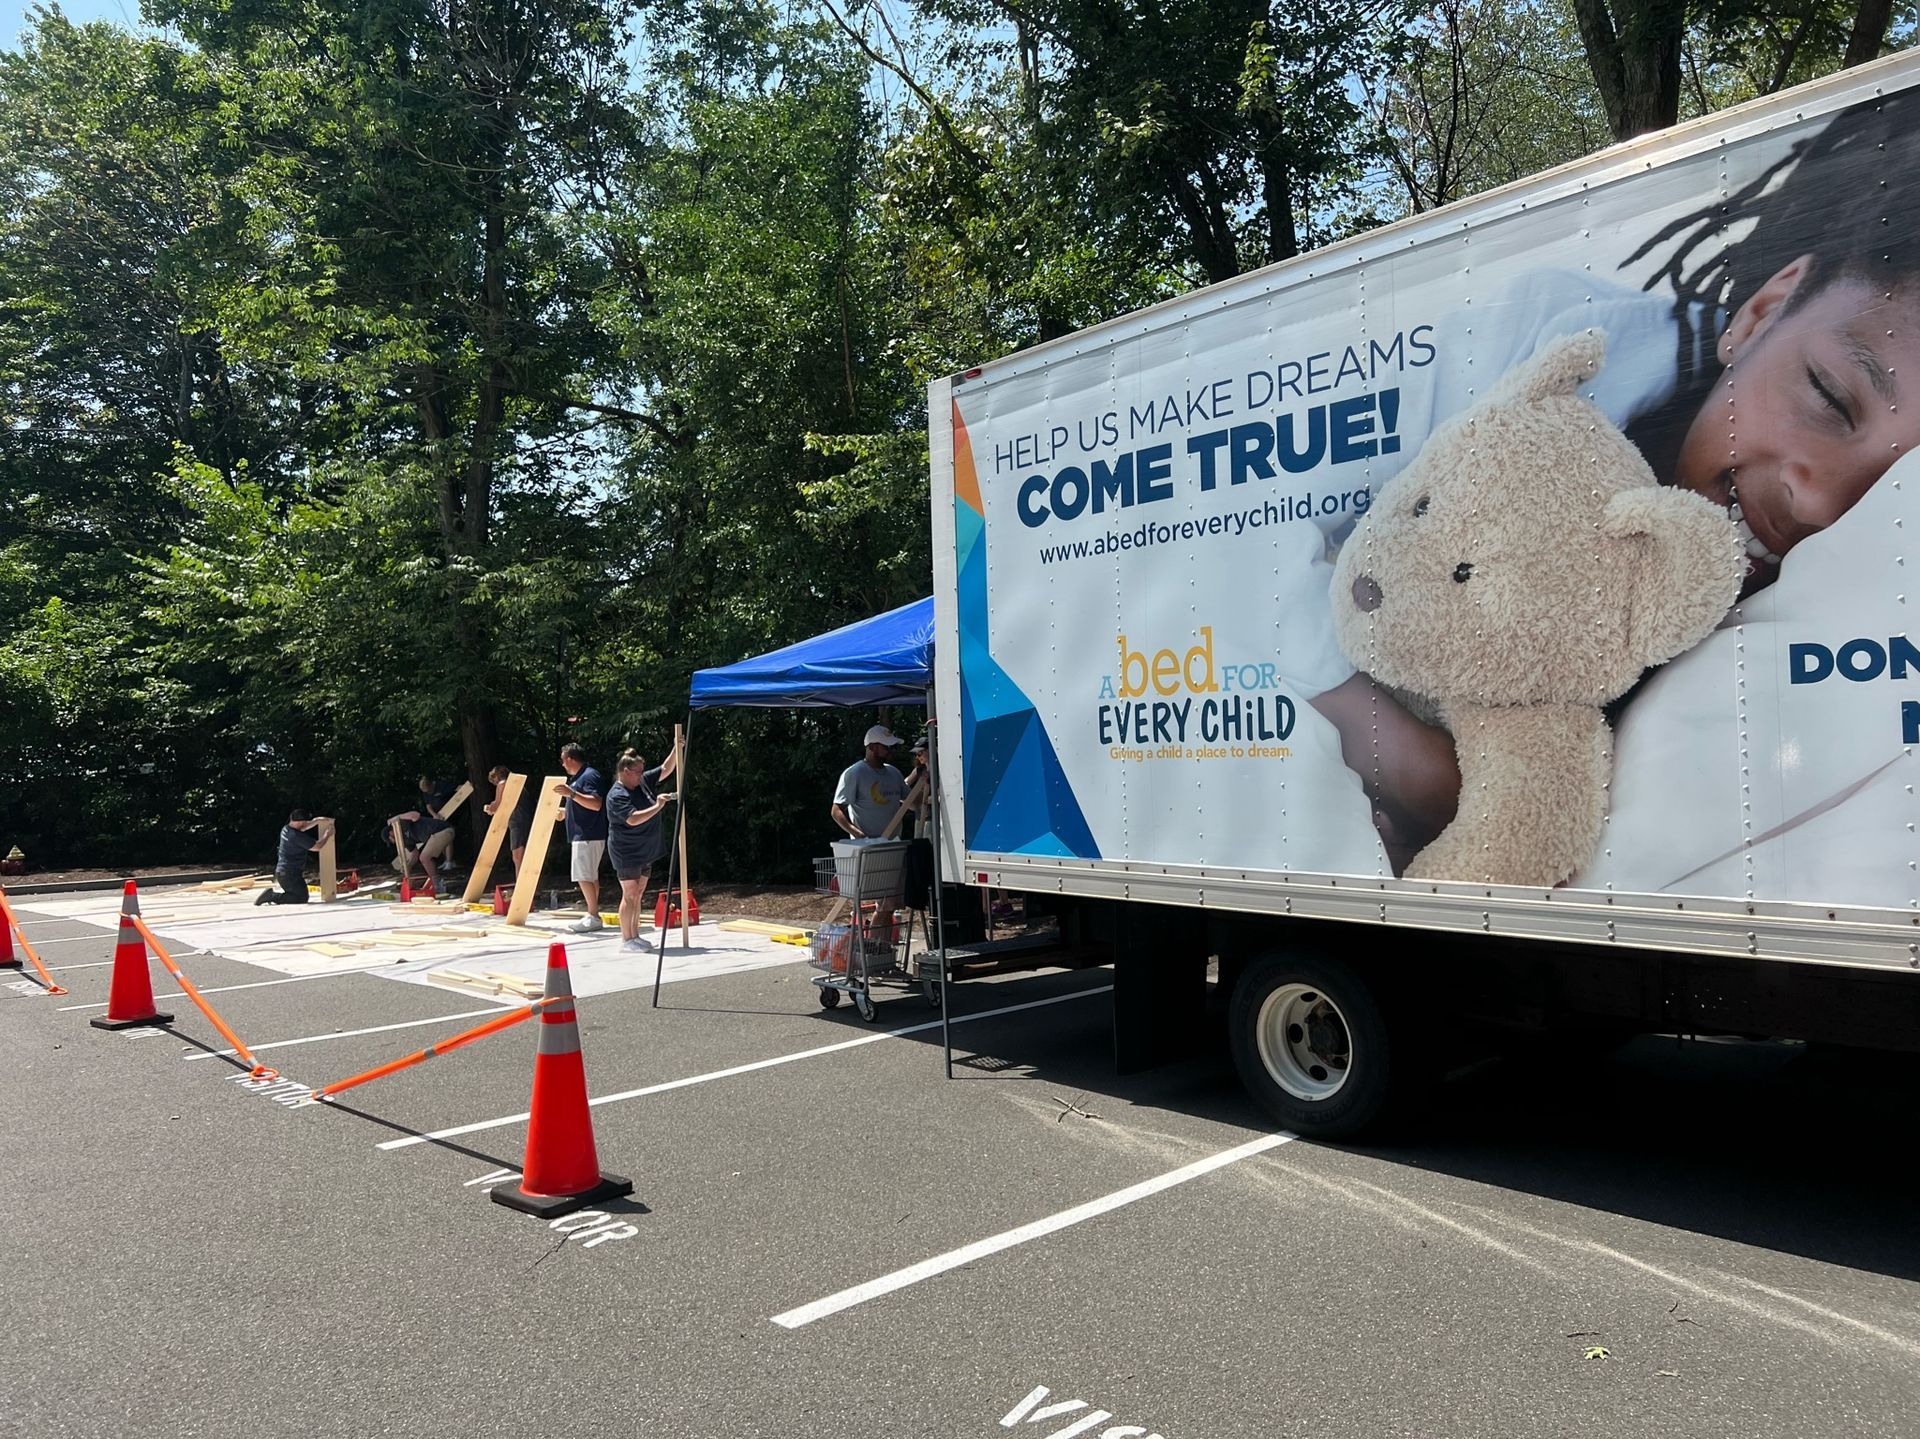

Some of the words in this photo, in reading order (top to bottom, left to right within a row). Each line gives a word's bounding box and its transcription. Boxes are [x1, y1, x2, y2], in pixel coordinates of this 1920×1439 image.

[995, 426, 1069, 474] HELP
[1078, 412, 1119, 452] US
[1130, 379, 1233, 440] MAKE
[1247, 325, 1436, 409] DREAMS
[1017, 443, 1173, 528] COME
[1187, 387, 1400, 491] TRUE!
[1039, 487, 1371, 565] www.abedforeverychild.org
[1099, 675, 1116, 699] A
[1117, 626, 1218, 698] bed
[1222, 662, 1279, 692] FOR
[1099, 697, 1192, 745] EVERY
[1109, 746, 1143, 762] Giving
[1146, 749, 1153, 759] a
[1156, 745, 1183, 759] child
[1186, 748, 1193, 759] a
[1196, 745, 1227, 760] place
[1231, 746, 1244, 758] to
[1248, 743, 1294, 759] dream.
